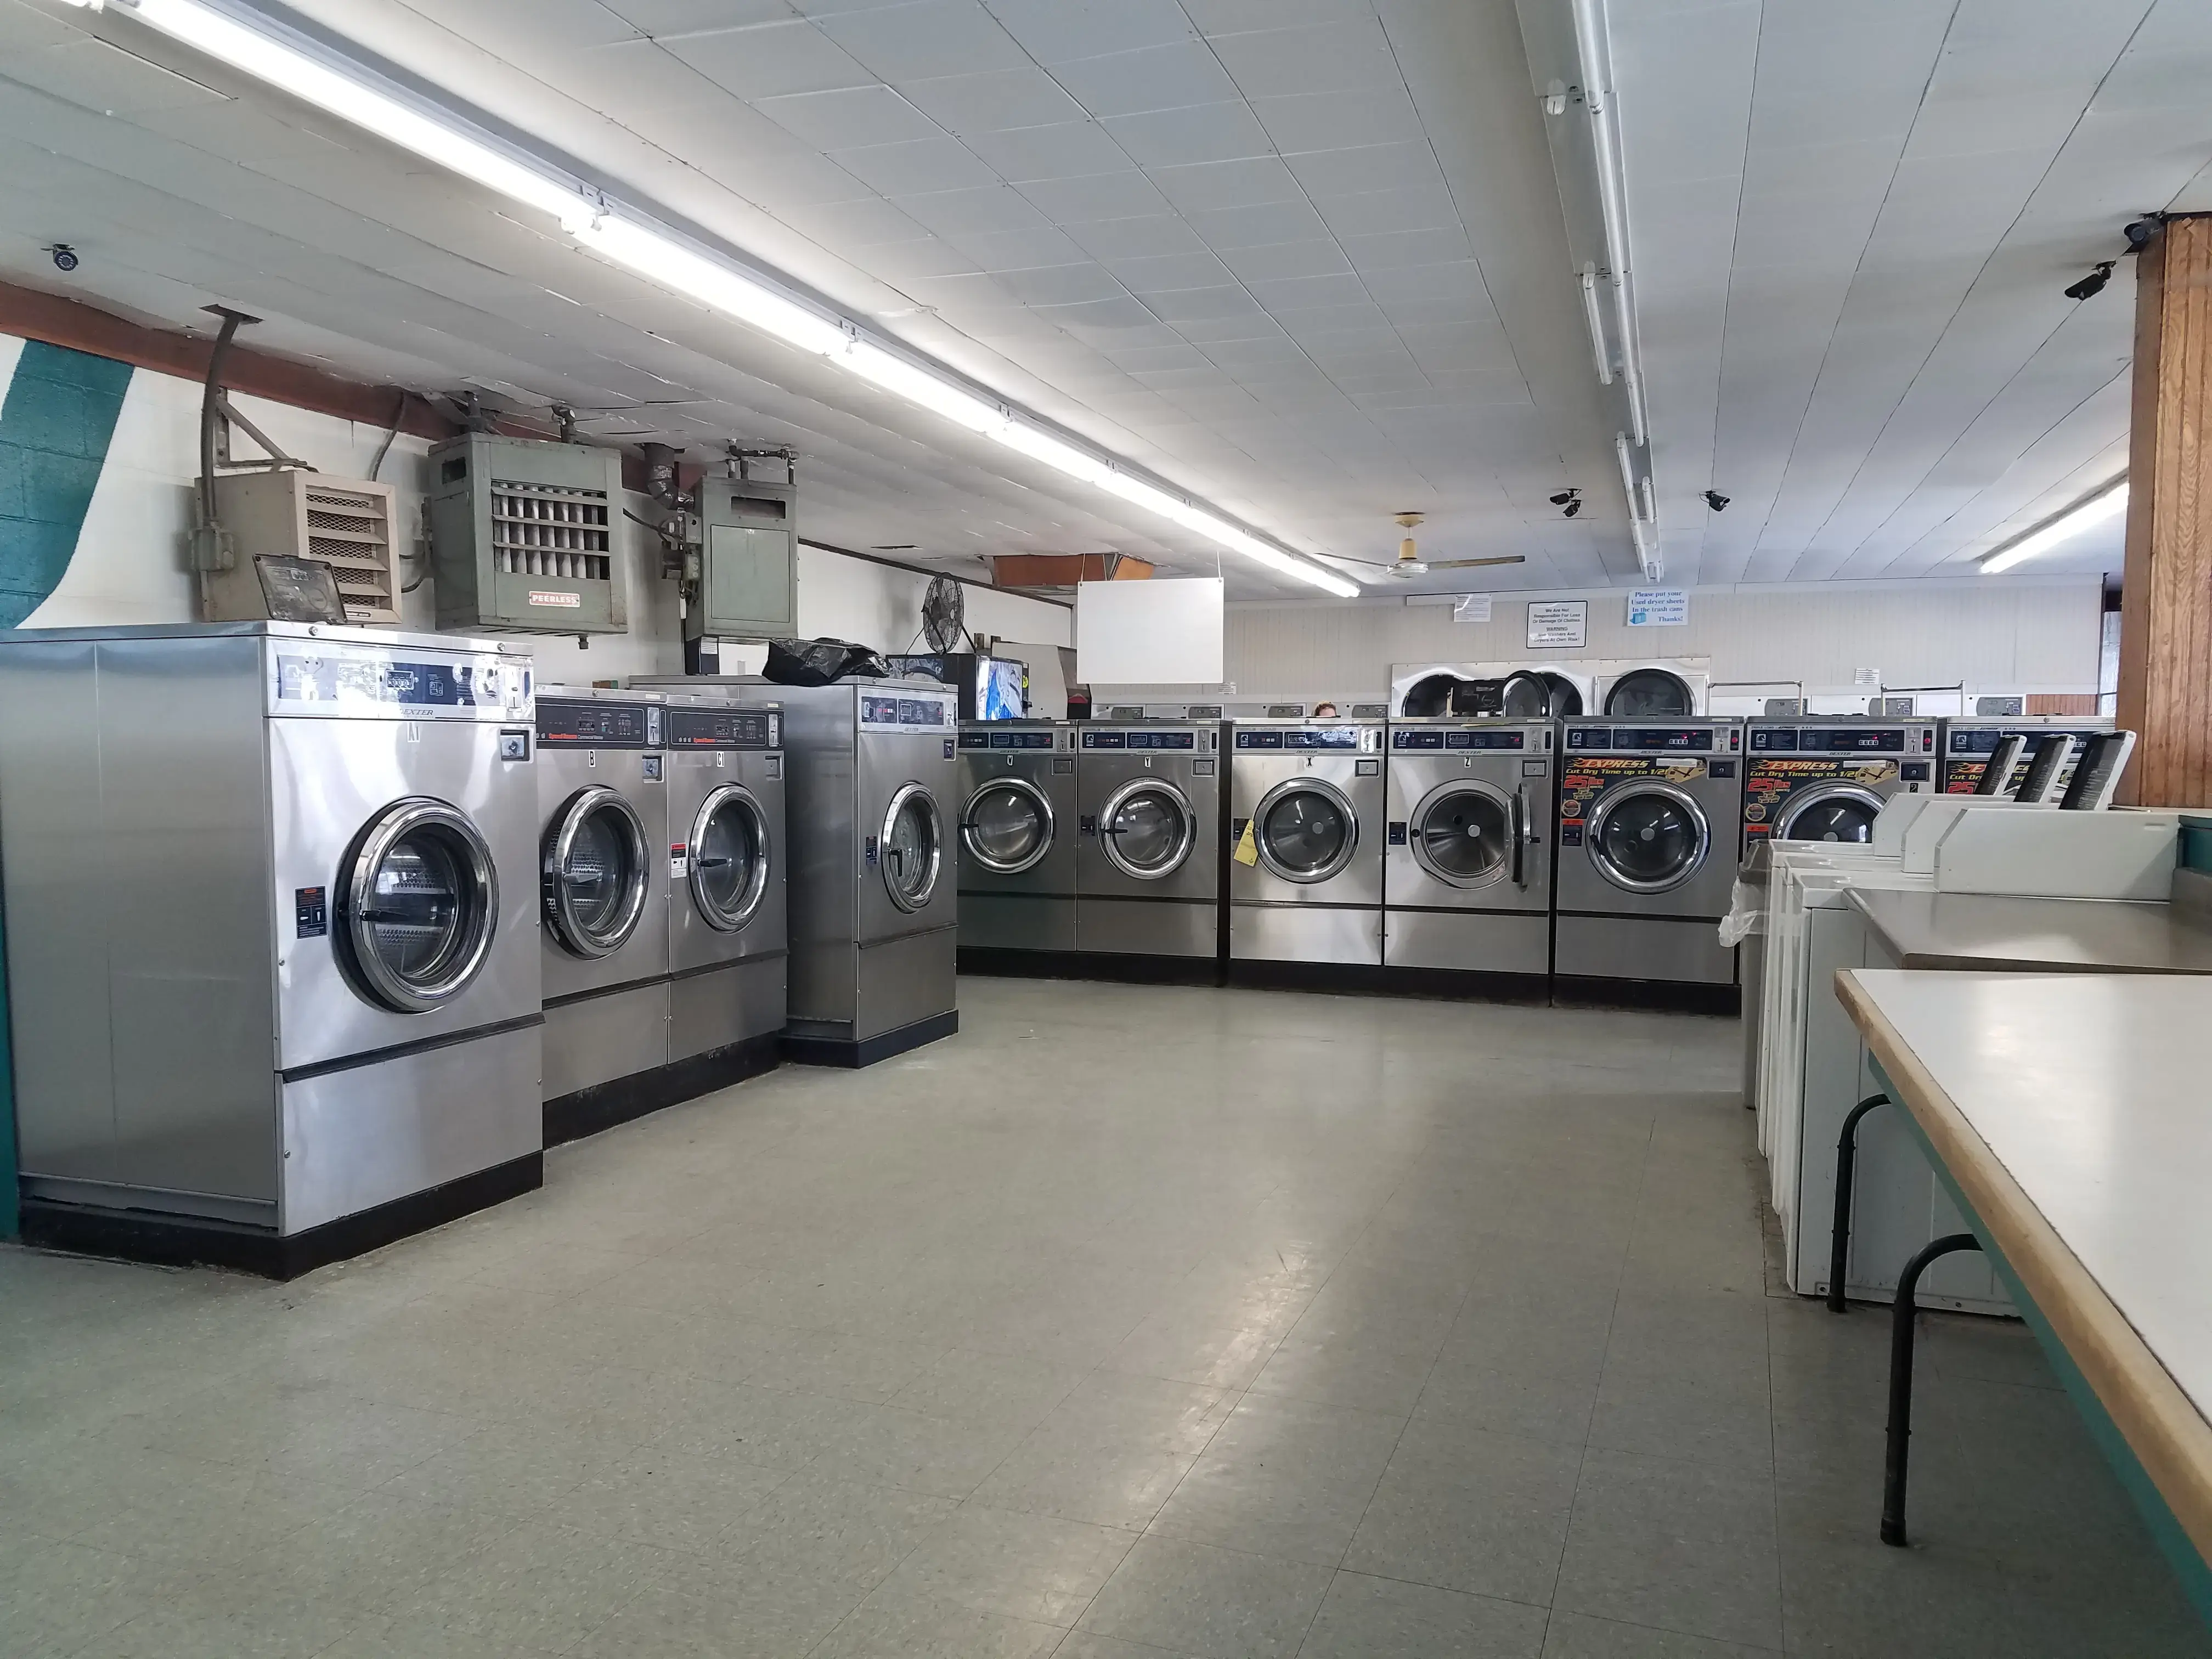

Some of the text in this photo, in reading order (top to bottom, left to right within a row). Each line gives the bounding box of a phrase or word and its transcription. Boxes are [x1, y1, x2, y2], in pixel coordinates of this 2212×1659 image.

[533, 595, 577, 603] PEERLESS
[590, 751, 594, 765] B
[1146, 758, 1149, 766] Y
[1307, 757, 1312, 766] X
[1465, 757, 1470, 766] Z
[1564, 775, 1589, 788] 25
[1747, 778, 1775, 792] 25
[1948, 781, 1975, 794] 25
